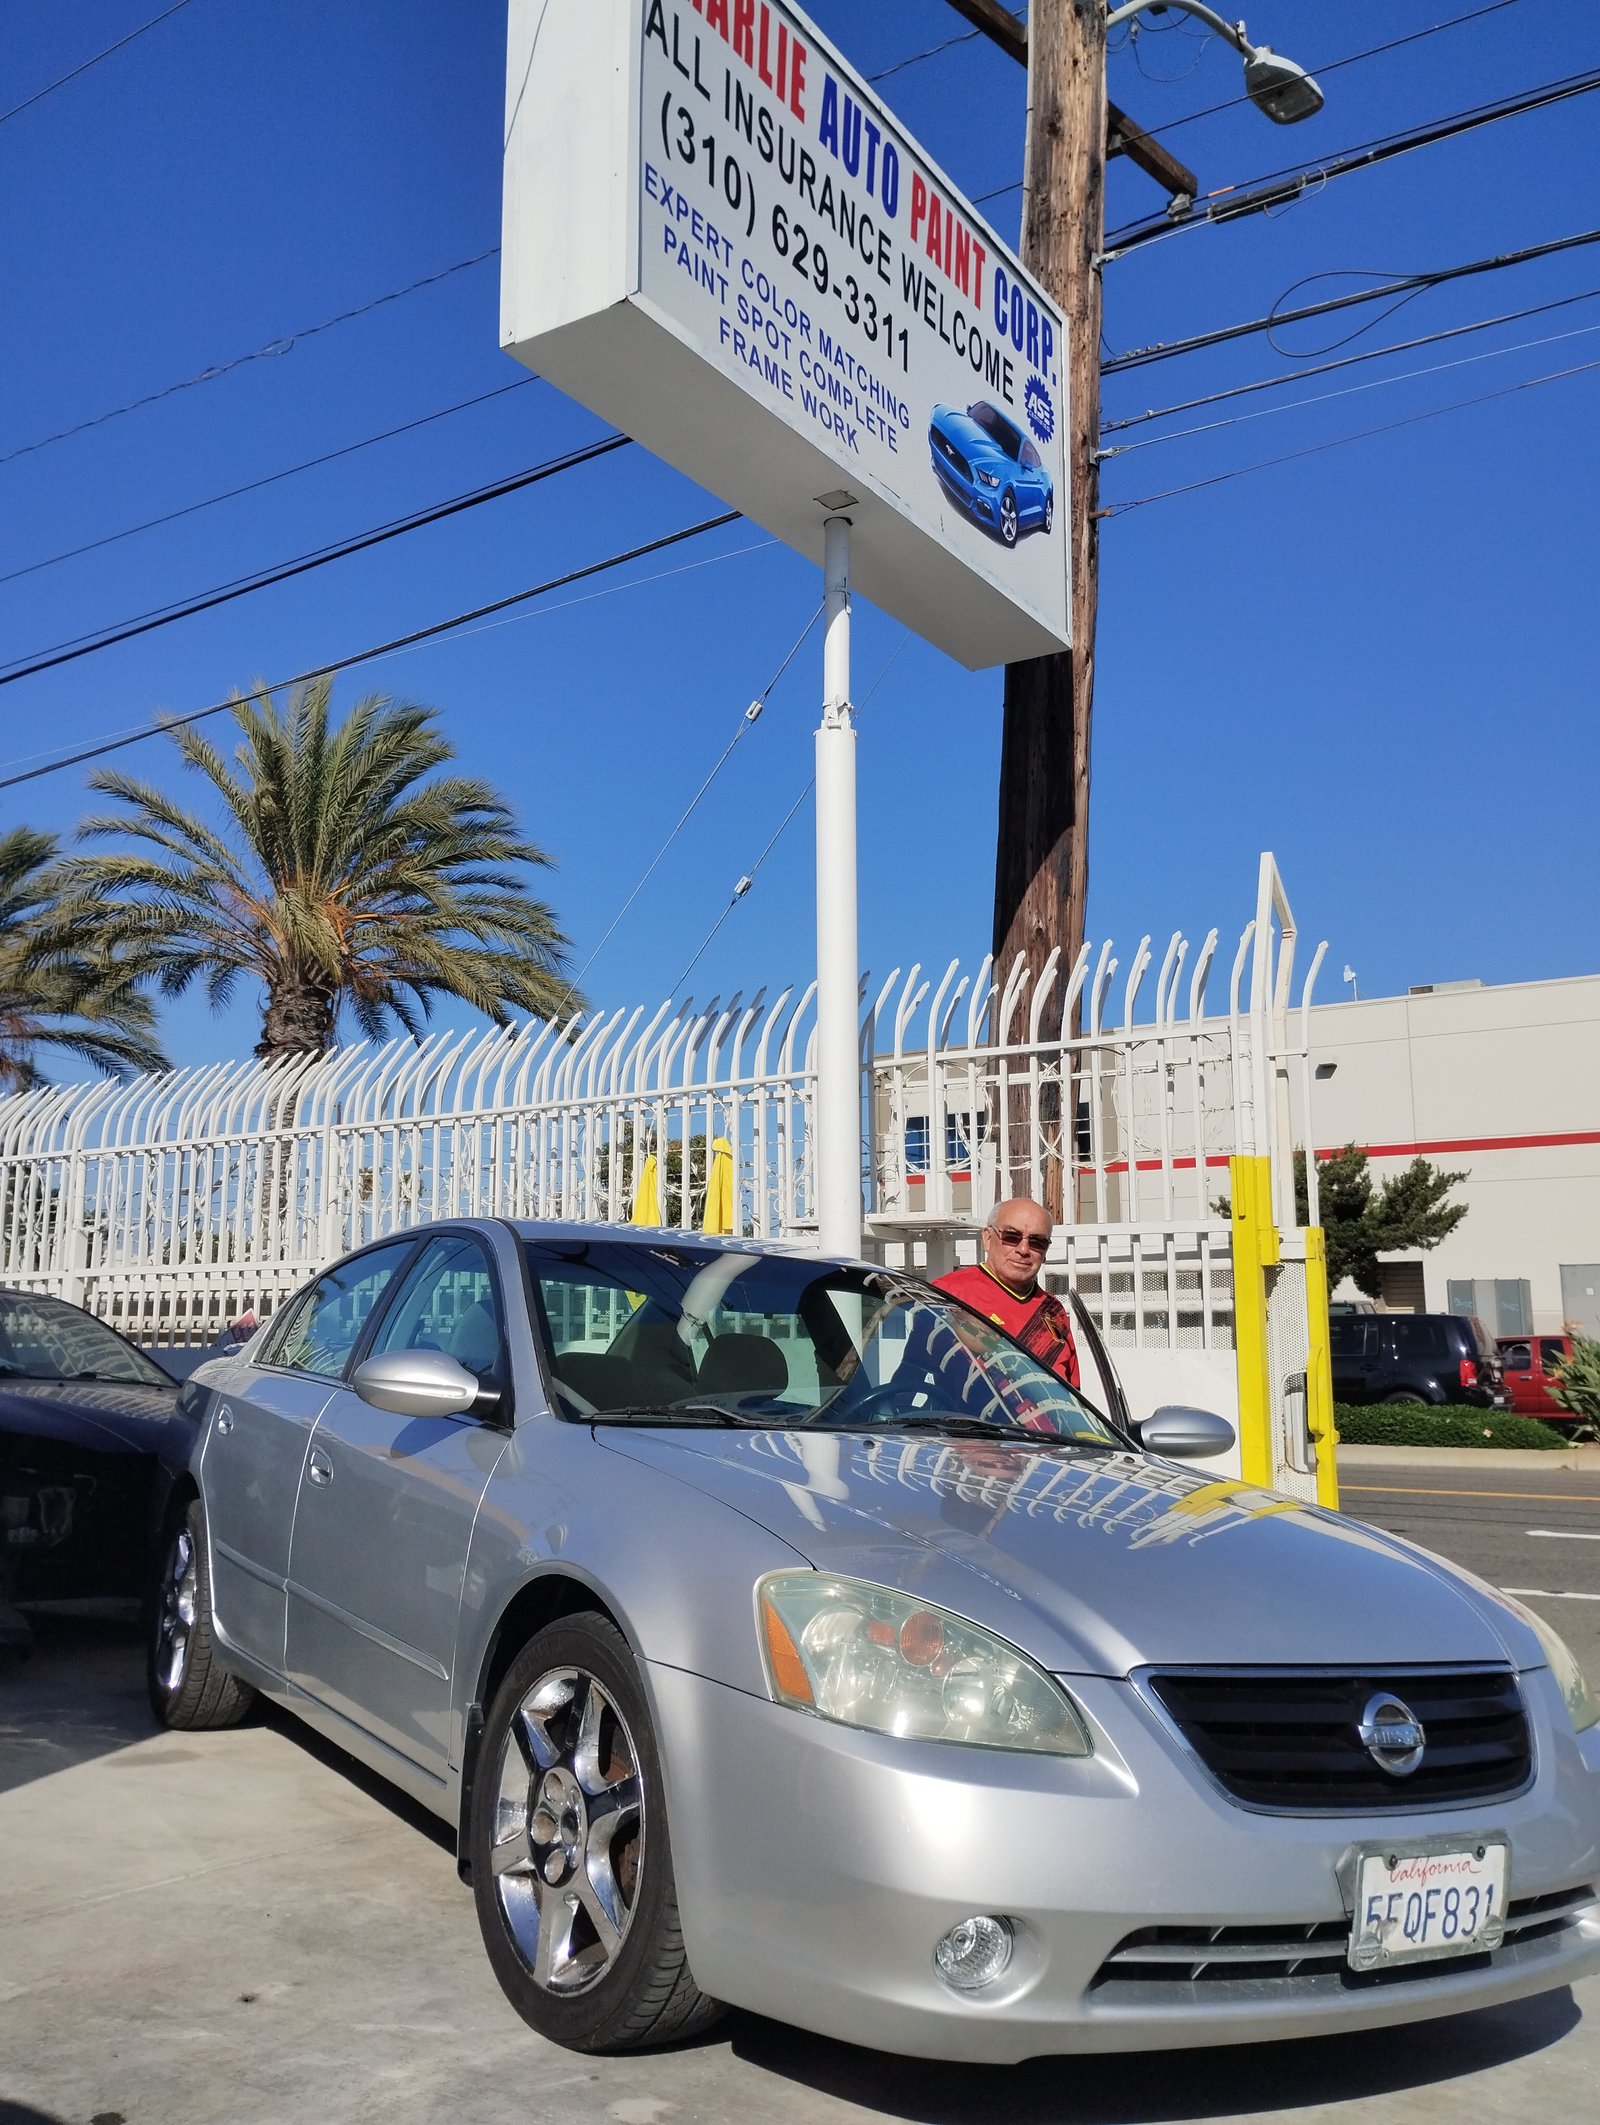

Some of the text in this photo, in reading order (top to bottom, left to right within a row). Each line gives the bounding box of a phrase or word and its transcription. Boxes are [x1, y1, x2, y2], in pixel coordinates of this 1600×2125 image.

[645, 0, 1014, 405] ALL INSURANCE WELCOME
[645, 162, 909, 429] EXPERT COLOR MATCHING
[662, 91, 908, 373] (310) 629-3311
[664, 224, 898, 454] PAINT SPOT COMPLETE
[819, 72, 899, 219] AUTO
[910, 170, 986, 311] PAINT
[994, 267, 1057, 387] CORP.
[720, 316, 859, 454] FRAME WORK
